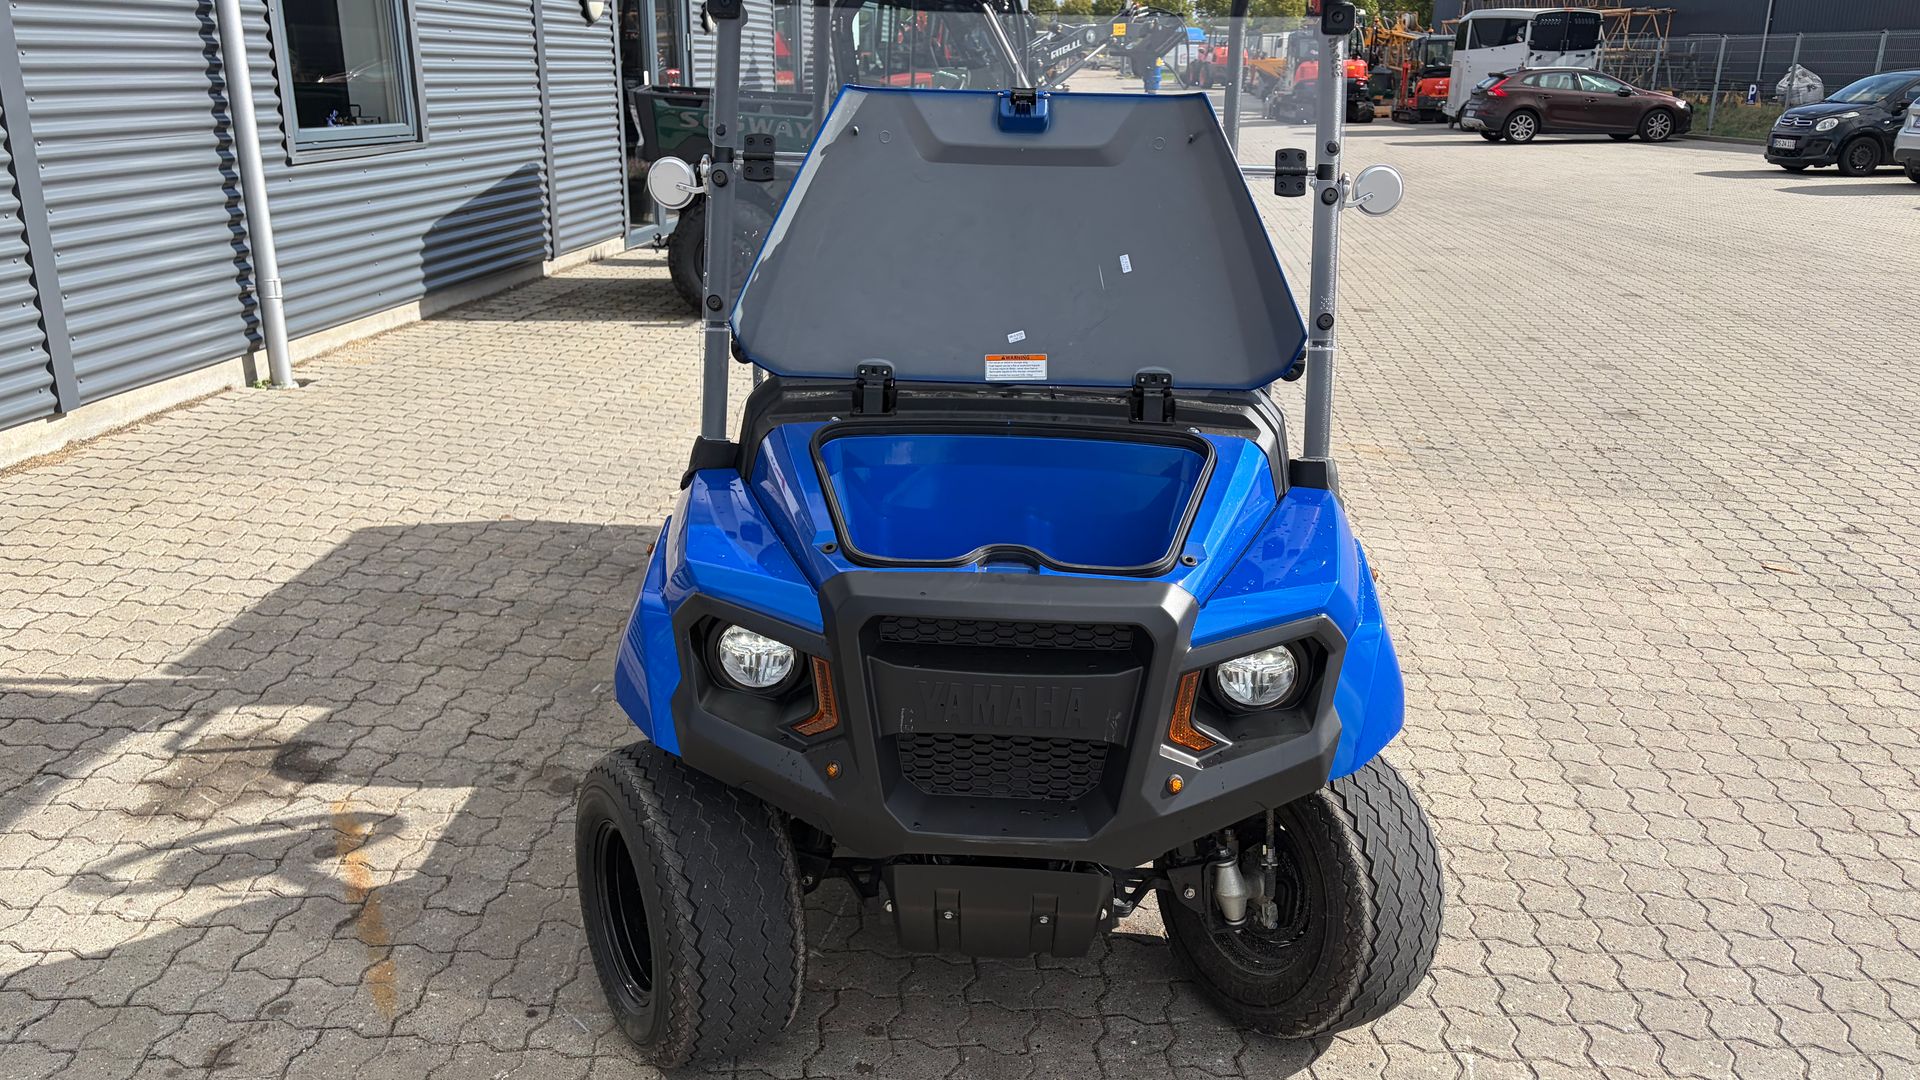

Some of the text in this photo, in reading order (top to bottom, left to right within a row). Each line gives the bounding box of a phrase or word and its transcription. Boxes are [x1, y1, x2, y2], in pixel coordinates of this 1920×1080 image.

[1050, 39, 1082, 60] PITBULL
[1747, 84, 1757, 100] P
[918, 681, 1085, 728] YAMAHA
